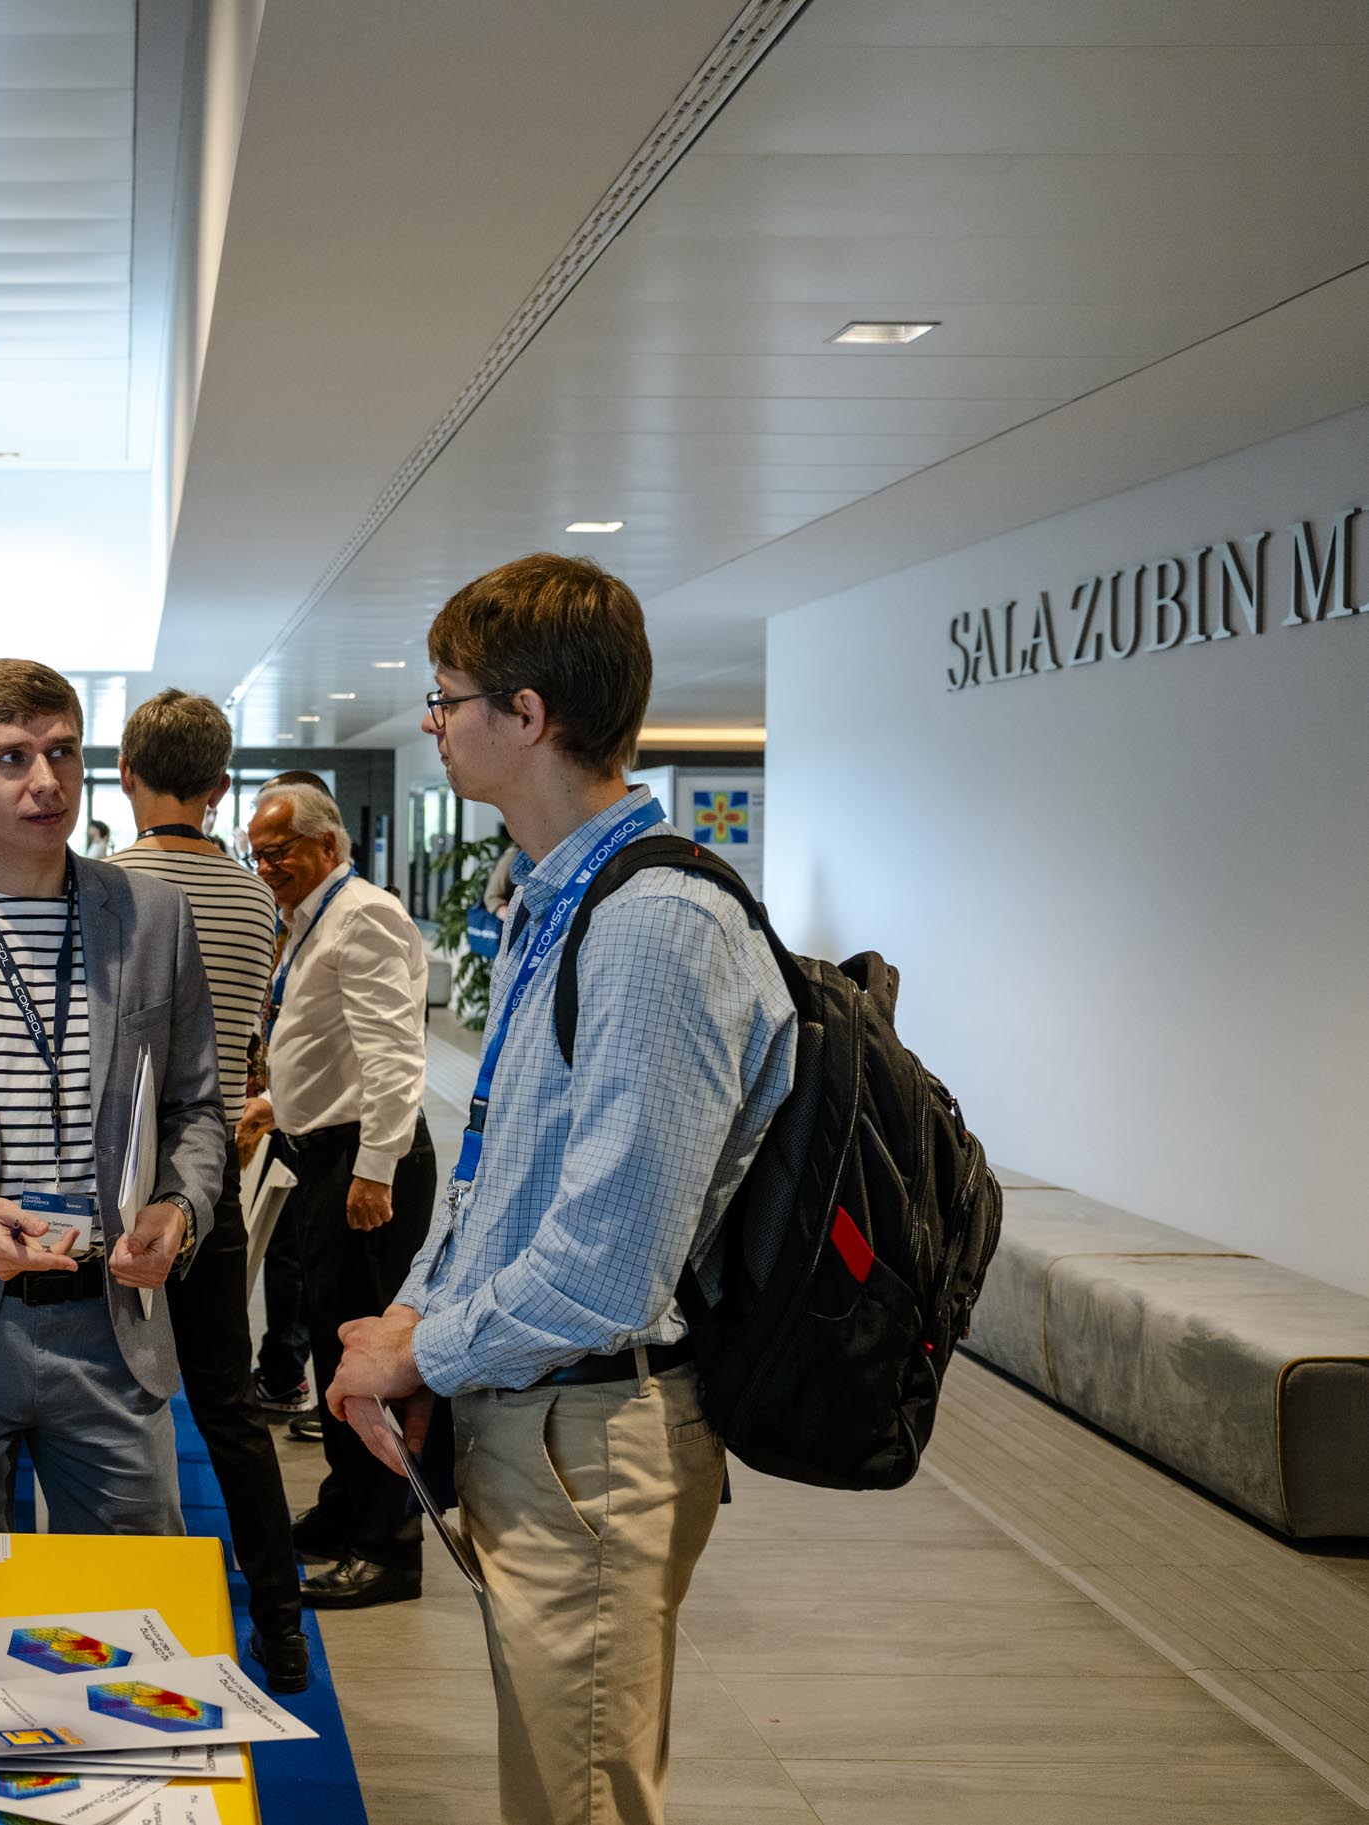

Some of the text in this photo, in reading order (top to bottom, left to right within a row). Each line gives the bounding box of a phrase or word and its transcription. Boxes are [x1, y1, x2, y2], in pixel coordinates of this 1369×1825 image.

[946, 505, 1369, 692] SALA ZUBIN M
[588, 819, 644, 871] COMSOL
[536, 897, 574, 955] COMSOL
[15, 987, 43, 1040] COMSOL
